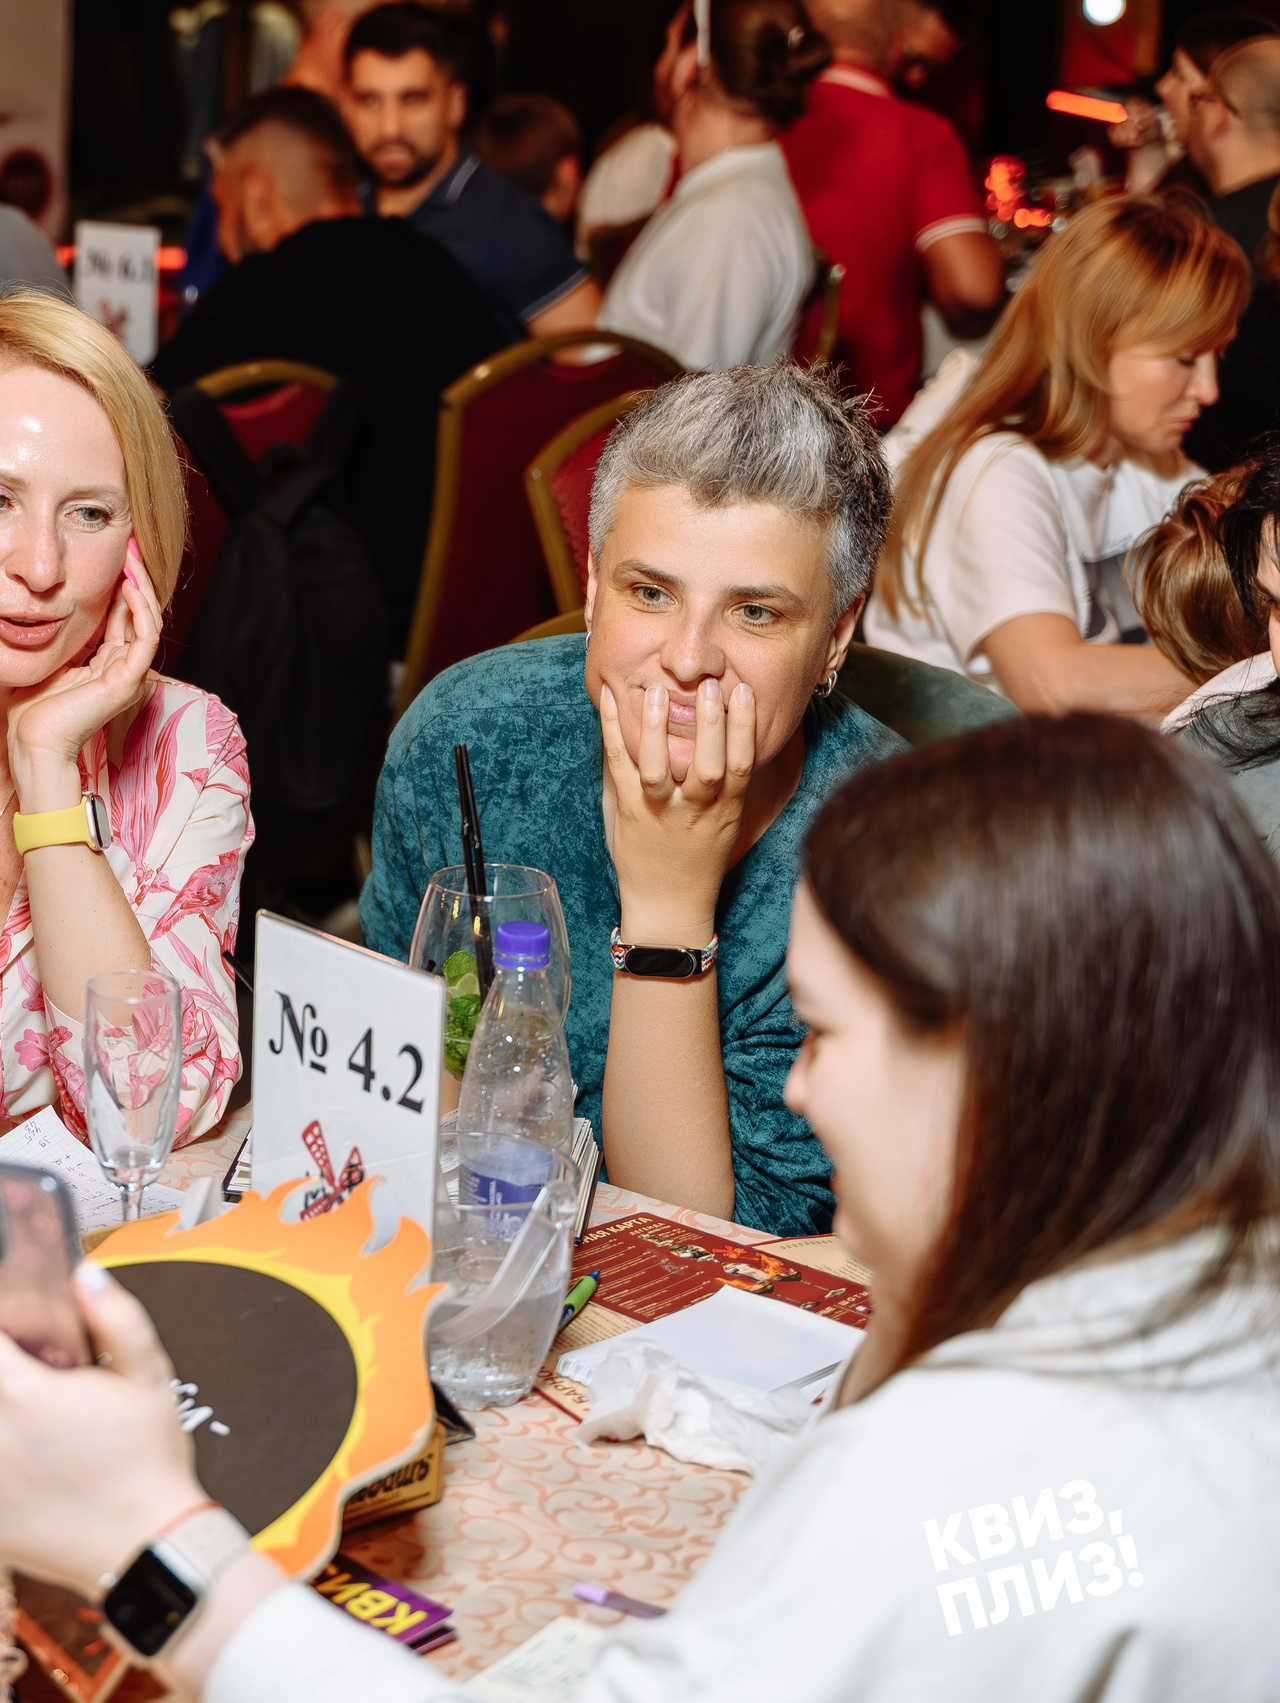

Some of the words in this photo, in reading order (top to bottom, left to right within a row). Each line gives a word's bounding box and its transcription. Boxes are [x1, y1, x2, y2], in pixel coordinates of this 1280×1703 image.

[269, 989, 328, 1074] №
[347, 1027, 425, 1114] 4.2
[573, 1229, 611, 1247] НАЯ
[606, 1216, 654, 1237] КАРТА
[309, 1561, 429, 1636] КВИ
